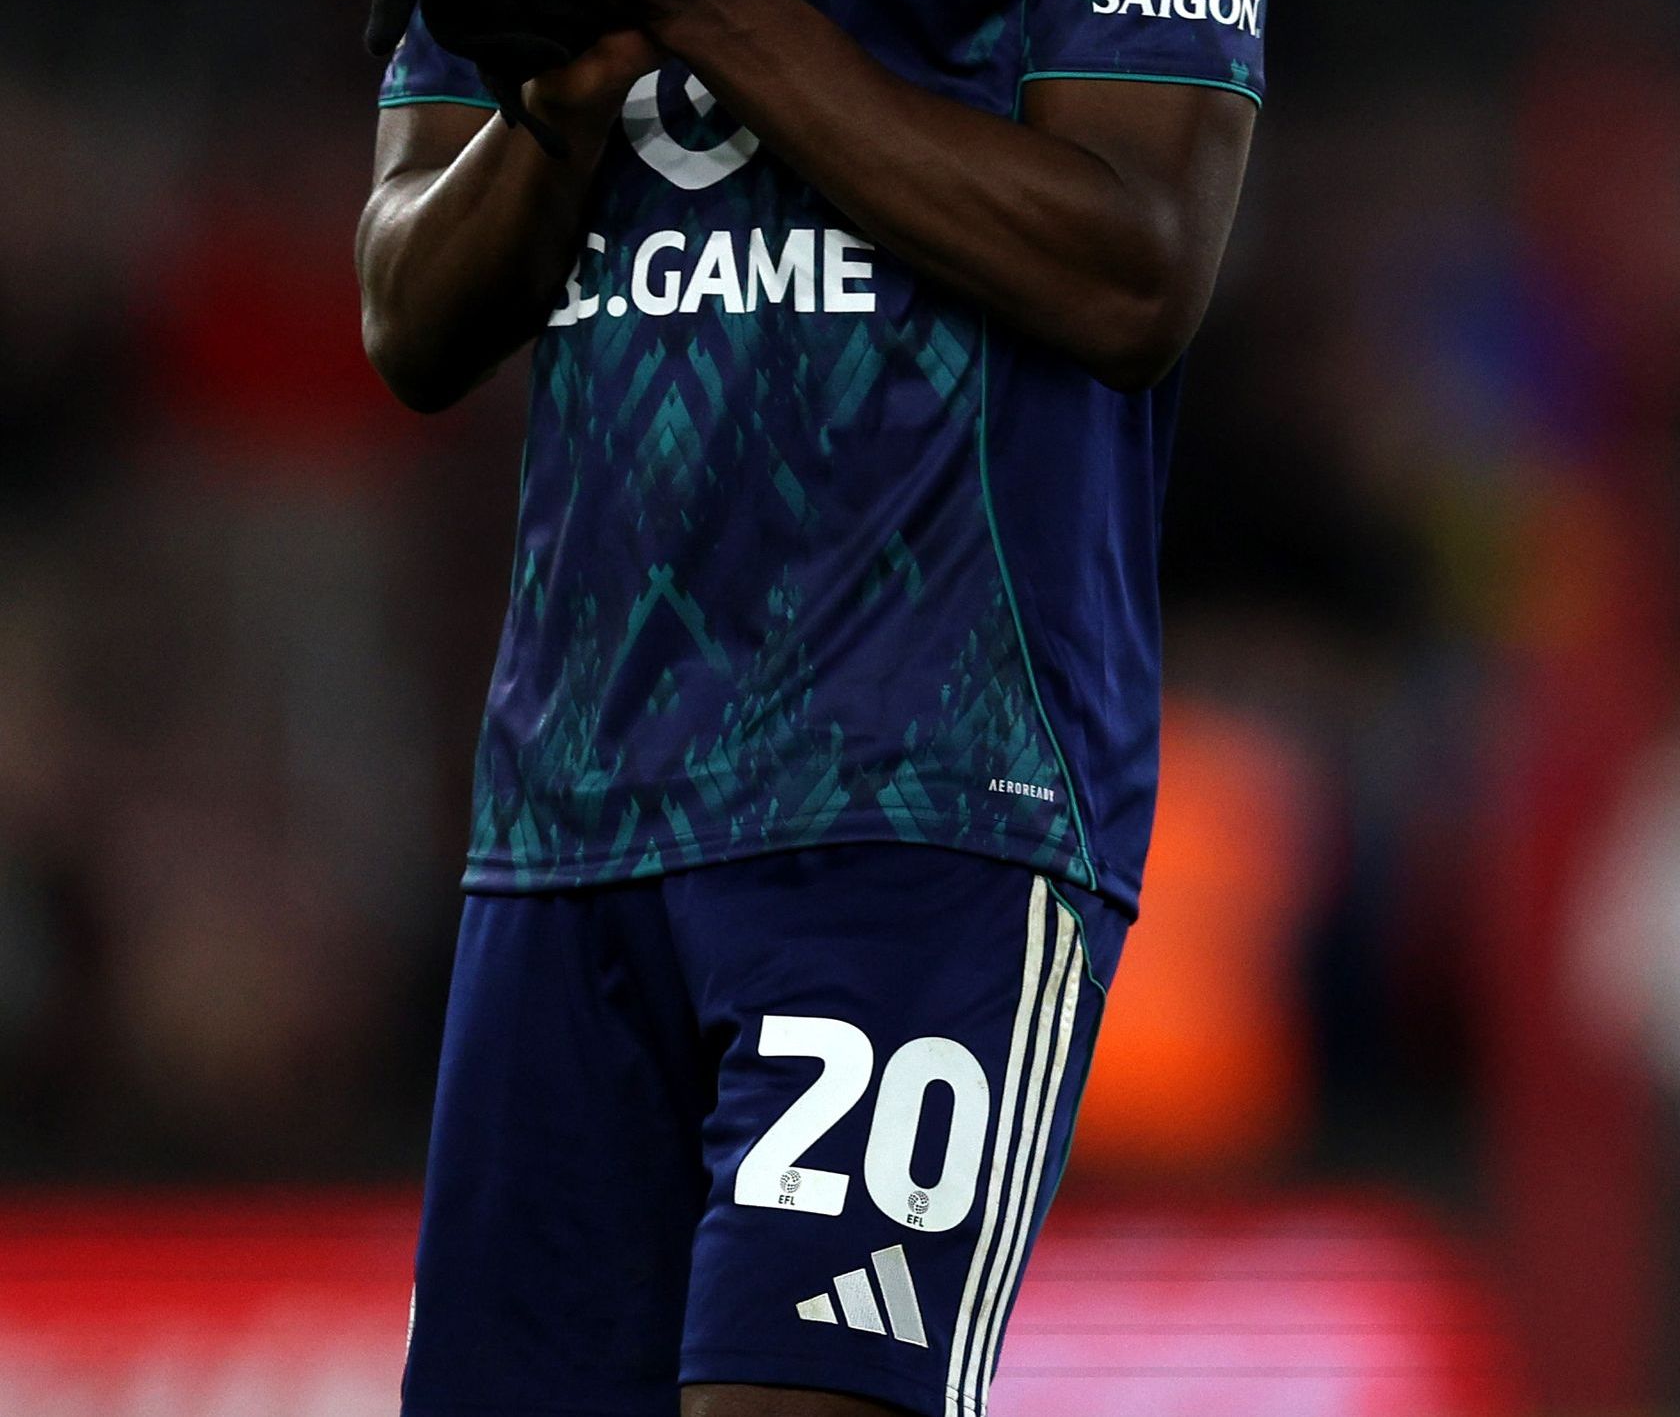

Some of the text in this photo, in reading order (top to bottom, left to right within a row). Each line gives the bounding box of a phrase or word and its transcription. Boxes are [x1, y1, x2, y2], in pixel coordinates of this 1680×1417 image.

[734, 1014, 991, 1232] 20
[778, 1194, 795, 1206] EFL
[906, 1214, 925, 1228] EFL
